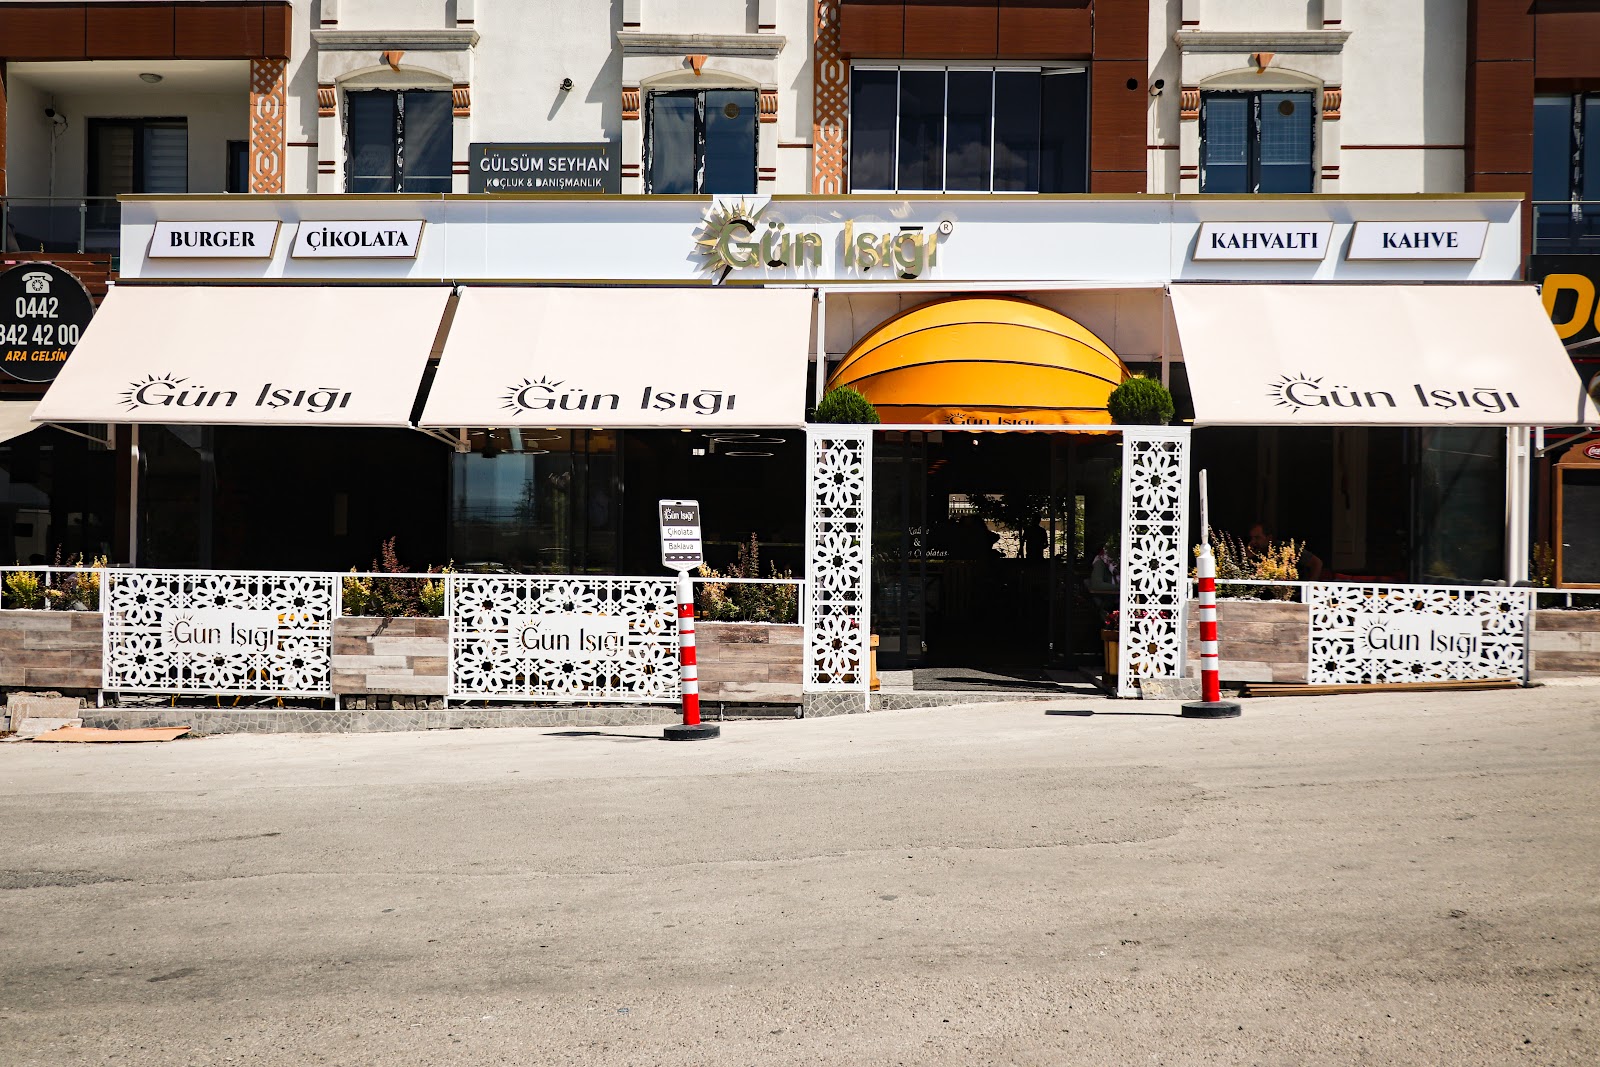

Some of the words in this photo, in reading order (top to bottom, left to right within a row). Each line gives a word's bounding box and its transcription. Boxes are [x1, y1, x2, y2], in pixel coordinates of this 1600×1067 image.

[480, 154, 544, 172] GÜLSÜM
[548, 157, 610, 172] SEYHAN
[486, 178, 524, 189] KOÇLUK
[527, 178, 533, 187] &
[535, 178, 602, 189] DANIŞMANLIK
[170, 230, 255, 248] BURGER
[306, 227, 409, 252] ÇİKOLATA
[719, 218, 823, 269] Gün
[1210, 231, 1319, 250] KAHVALTI
[1382, 231, 1459, 250] KAHVE
[15, 296, 59, 319] 0442
[32, 323, 54, 346] 42
[58, 323, 80, 346] 00
[5, 350, 27, 361] ARA
[31, 347, 68, 362] GELSİN
[136, 381, 238, 408] Gün
[516, 386, 620, 413] Gün
[1285, 380, 1397, 410] Gün
[667, 527, 693, 538] Çikolata
[669, 542, 694, 550] Baklava
[172, 618, 222, 646] Gün
[520, 625, 570, 652] Gün
[1367, 625, 1421, 653] Gün
